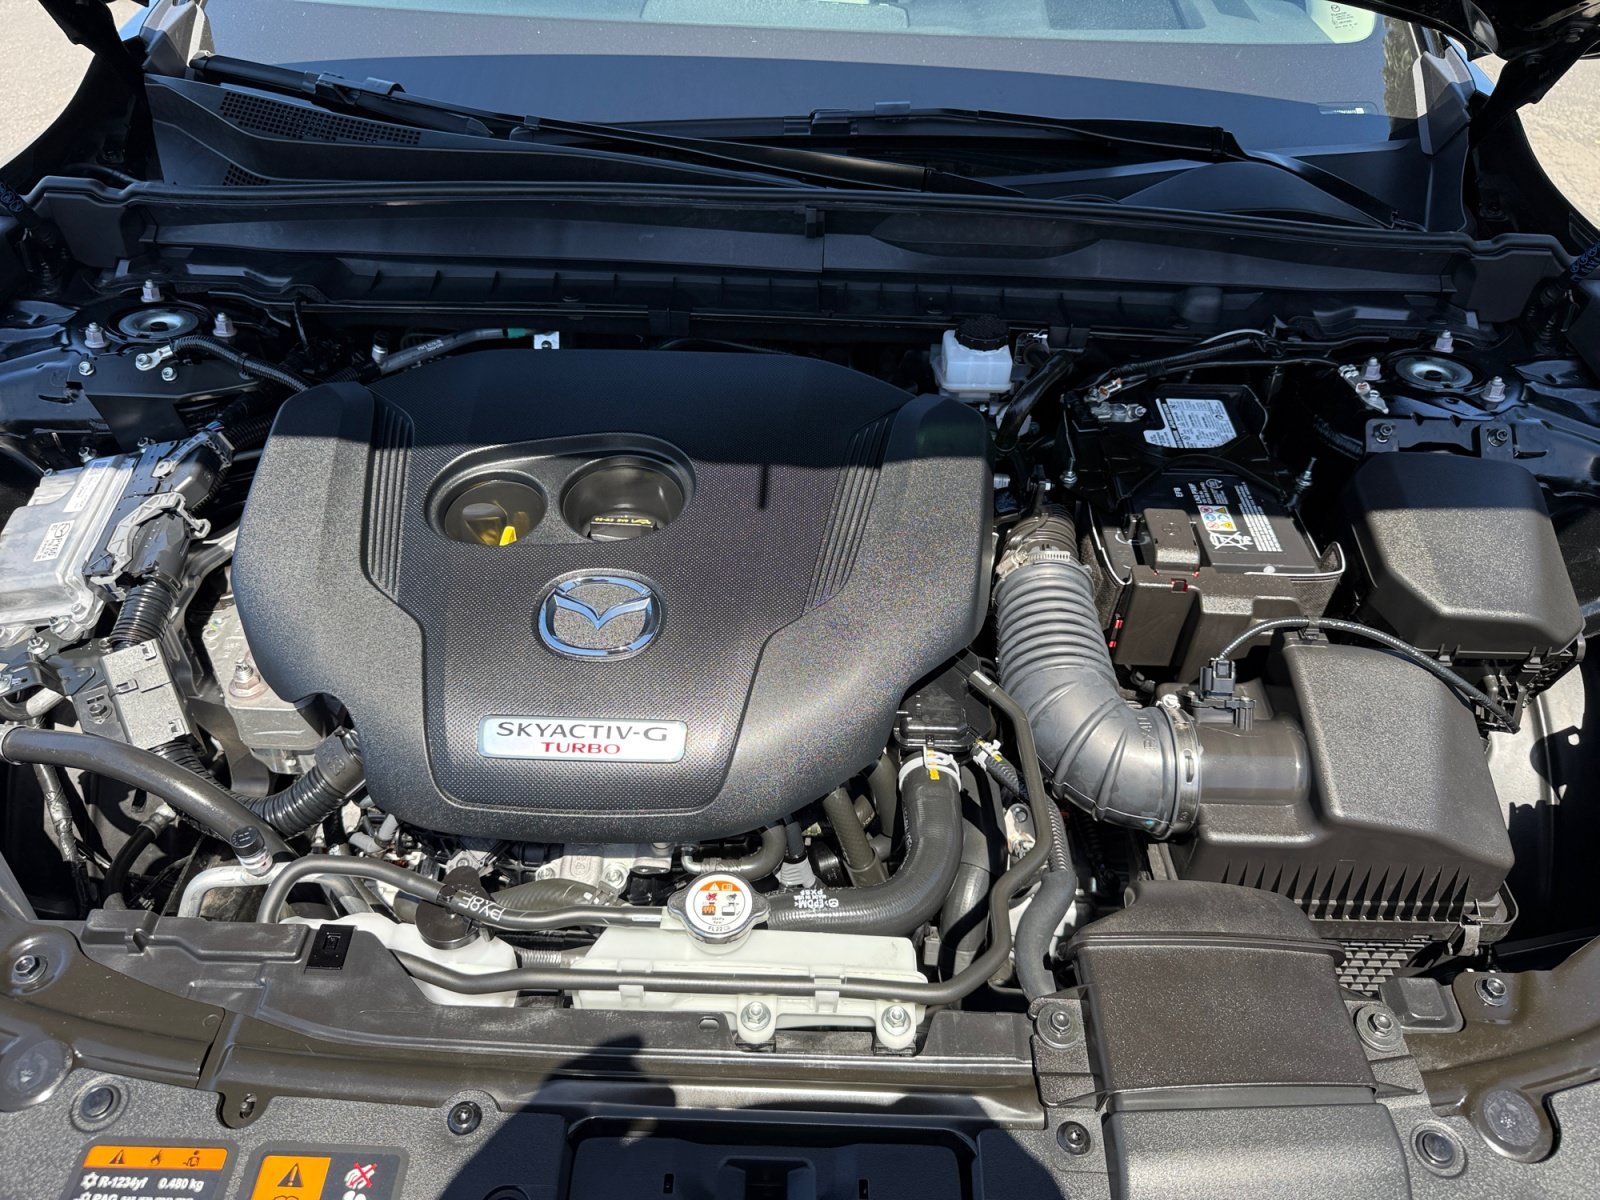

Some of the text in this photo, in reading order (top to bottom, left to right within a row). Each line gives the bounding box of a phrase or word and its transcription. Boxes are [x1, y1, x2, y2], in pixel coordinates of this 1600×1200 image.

[496, 721, 668, 741] SKYACTIV-G
[541, 742, 621, 754] TURBO
[97, 1175, 205, 1192] R-1234yf 0.480 kg
